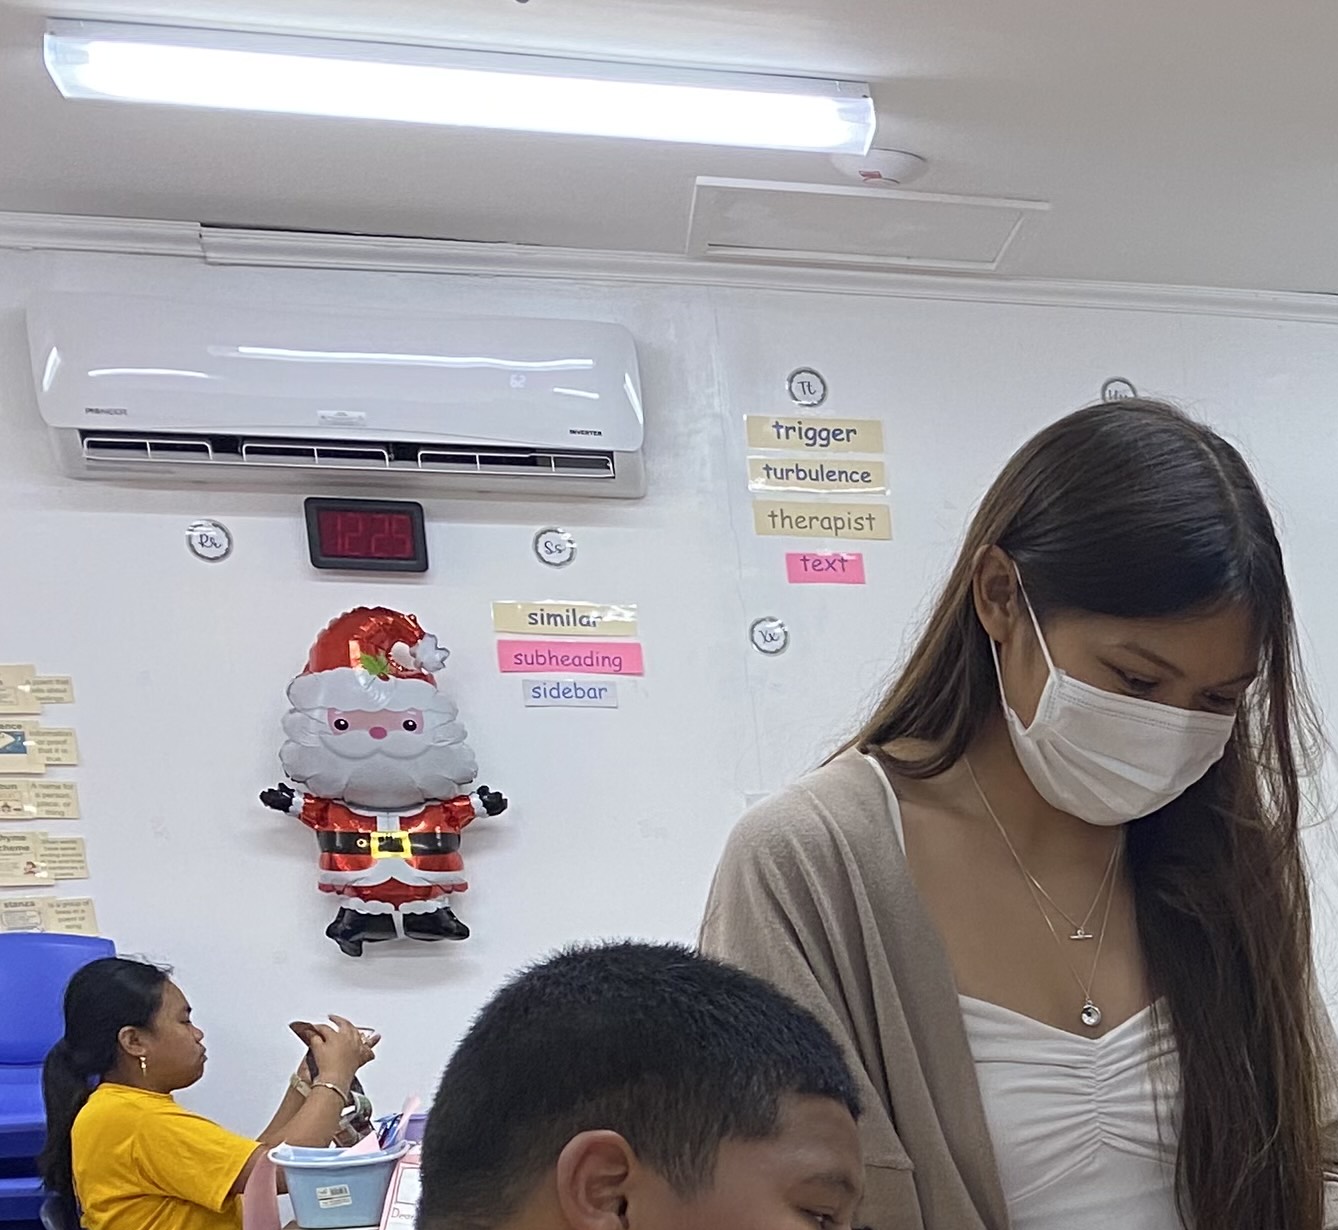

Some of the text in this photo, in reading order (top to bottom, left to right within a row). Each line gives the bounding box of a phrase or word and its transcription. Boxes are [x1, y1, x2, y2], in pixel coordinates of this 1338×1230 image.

[772, 421, 857, 447] trigger
[763, 463, 872, 483] turbulence
[768, 509, 876, 536] therapist
[800, 555, 848, 573] text
[528, 608, 603, 628] similar
[513, 650, 623, 672] subheading
[531, 682, 608, 700] sidebar
